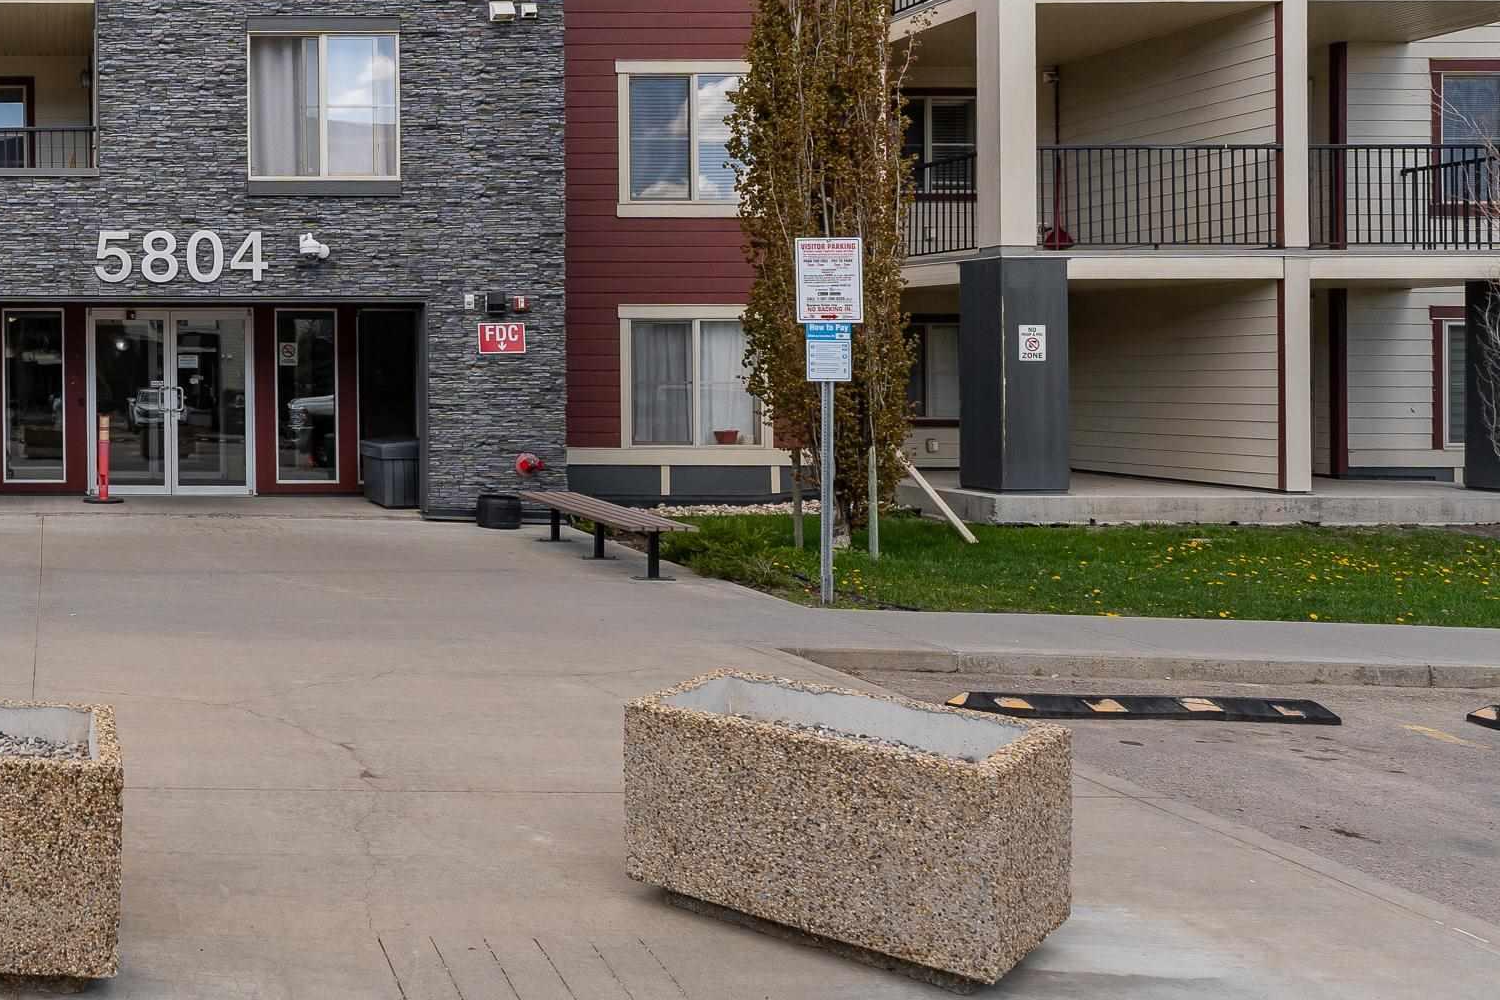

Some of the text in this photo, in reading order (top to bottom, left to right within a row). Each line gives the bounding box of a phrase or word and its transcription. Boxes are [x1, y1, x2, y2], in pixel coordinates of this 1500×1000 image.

[94, 229, 269, 283] 5804
[485, 324, 519, 342] FDC
[809, 323, 849, 333] How to Pay
